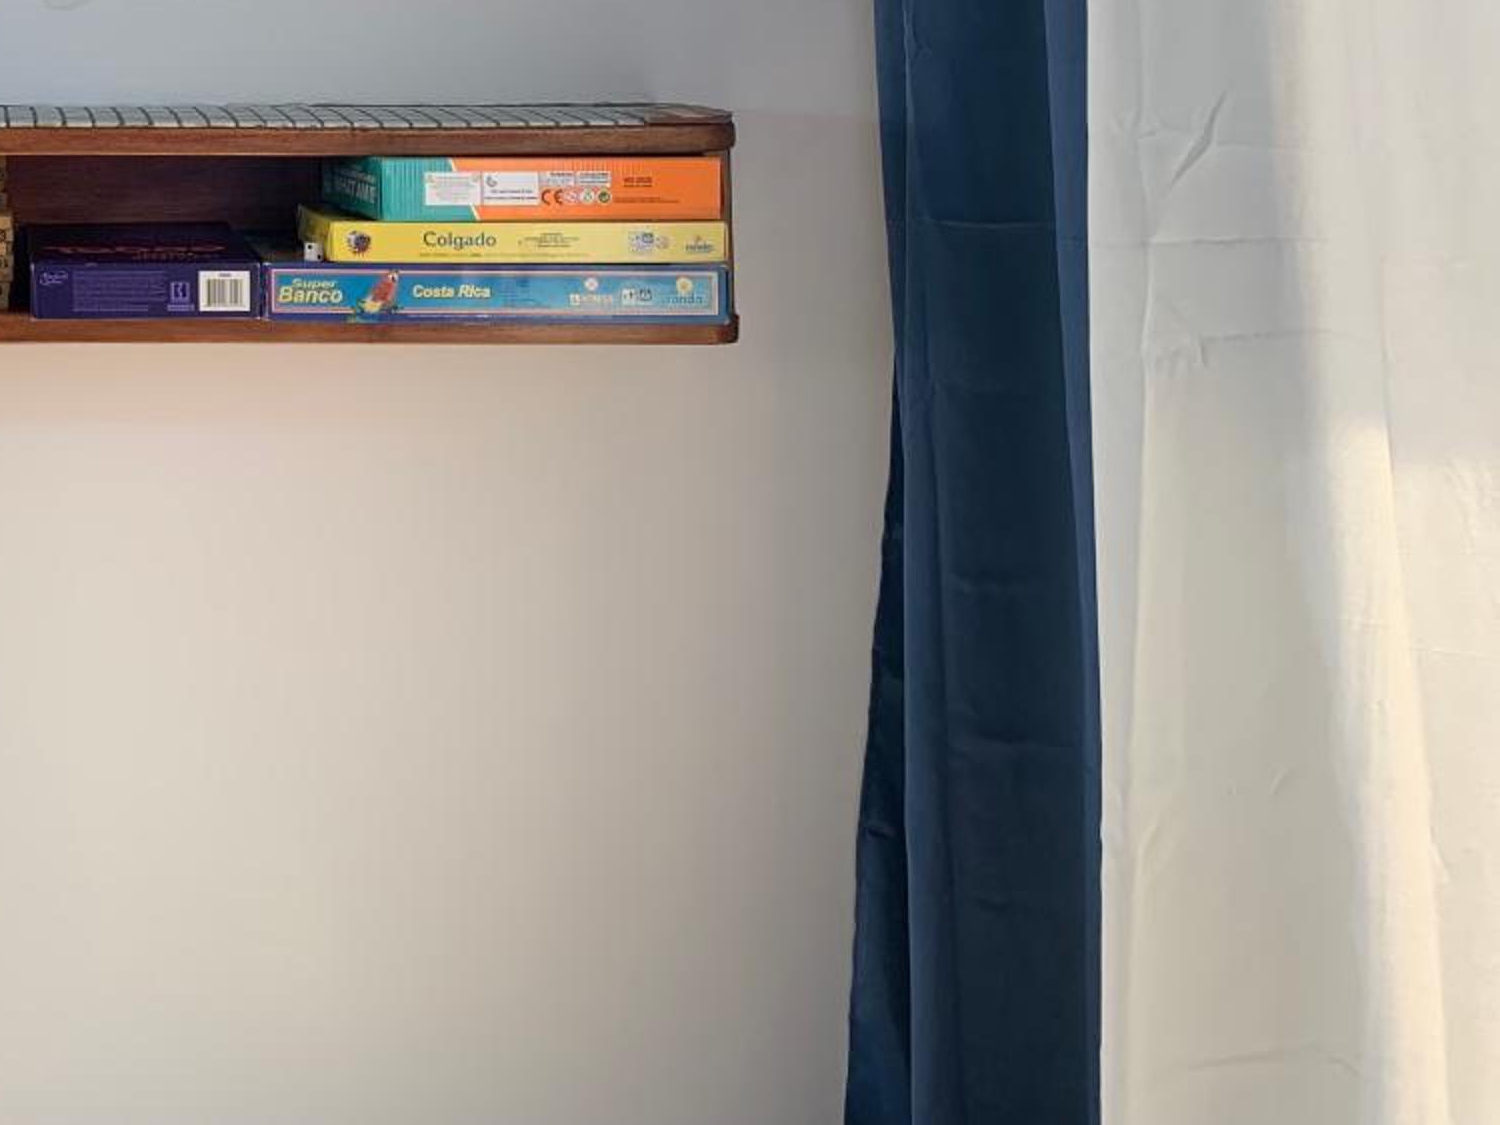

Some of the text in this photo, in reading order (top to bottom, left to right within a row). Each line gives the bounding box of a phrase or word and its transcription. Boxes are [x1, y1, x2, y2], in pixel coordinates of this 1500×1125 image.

[423, 231, 497, 251] Colgado
[291, 278, 336, 289] Super
[412, 284, 454, 298] Costa
[458, 284, 492, 299] Rica
[278, 286, 343, 303] Banco
